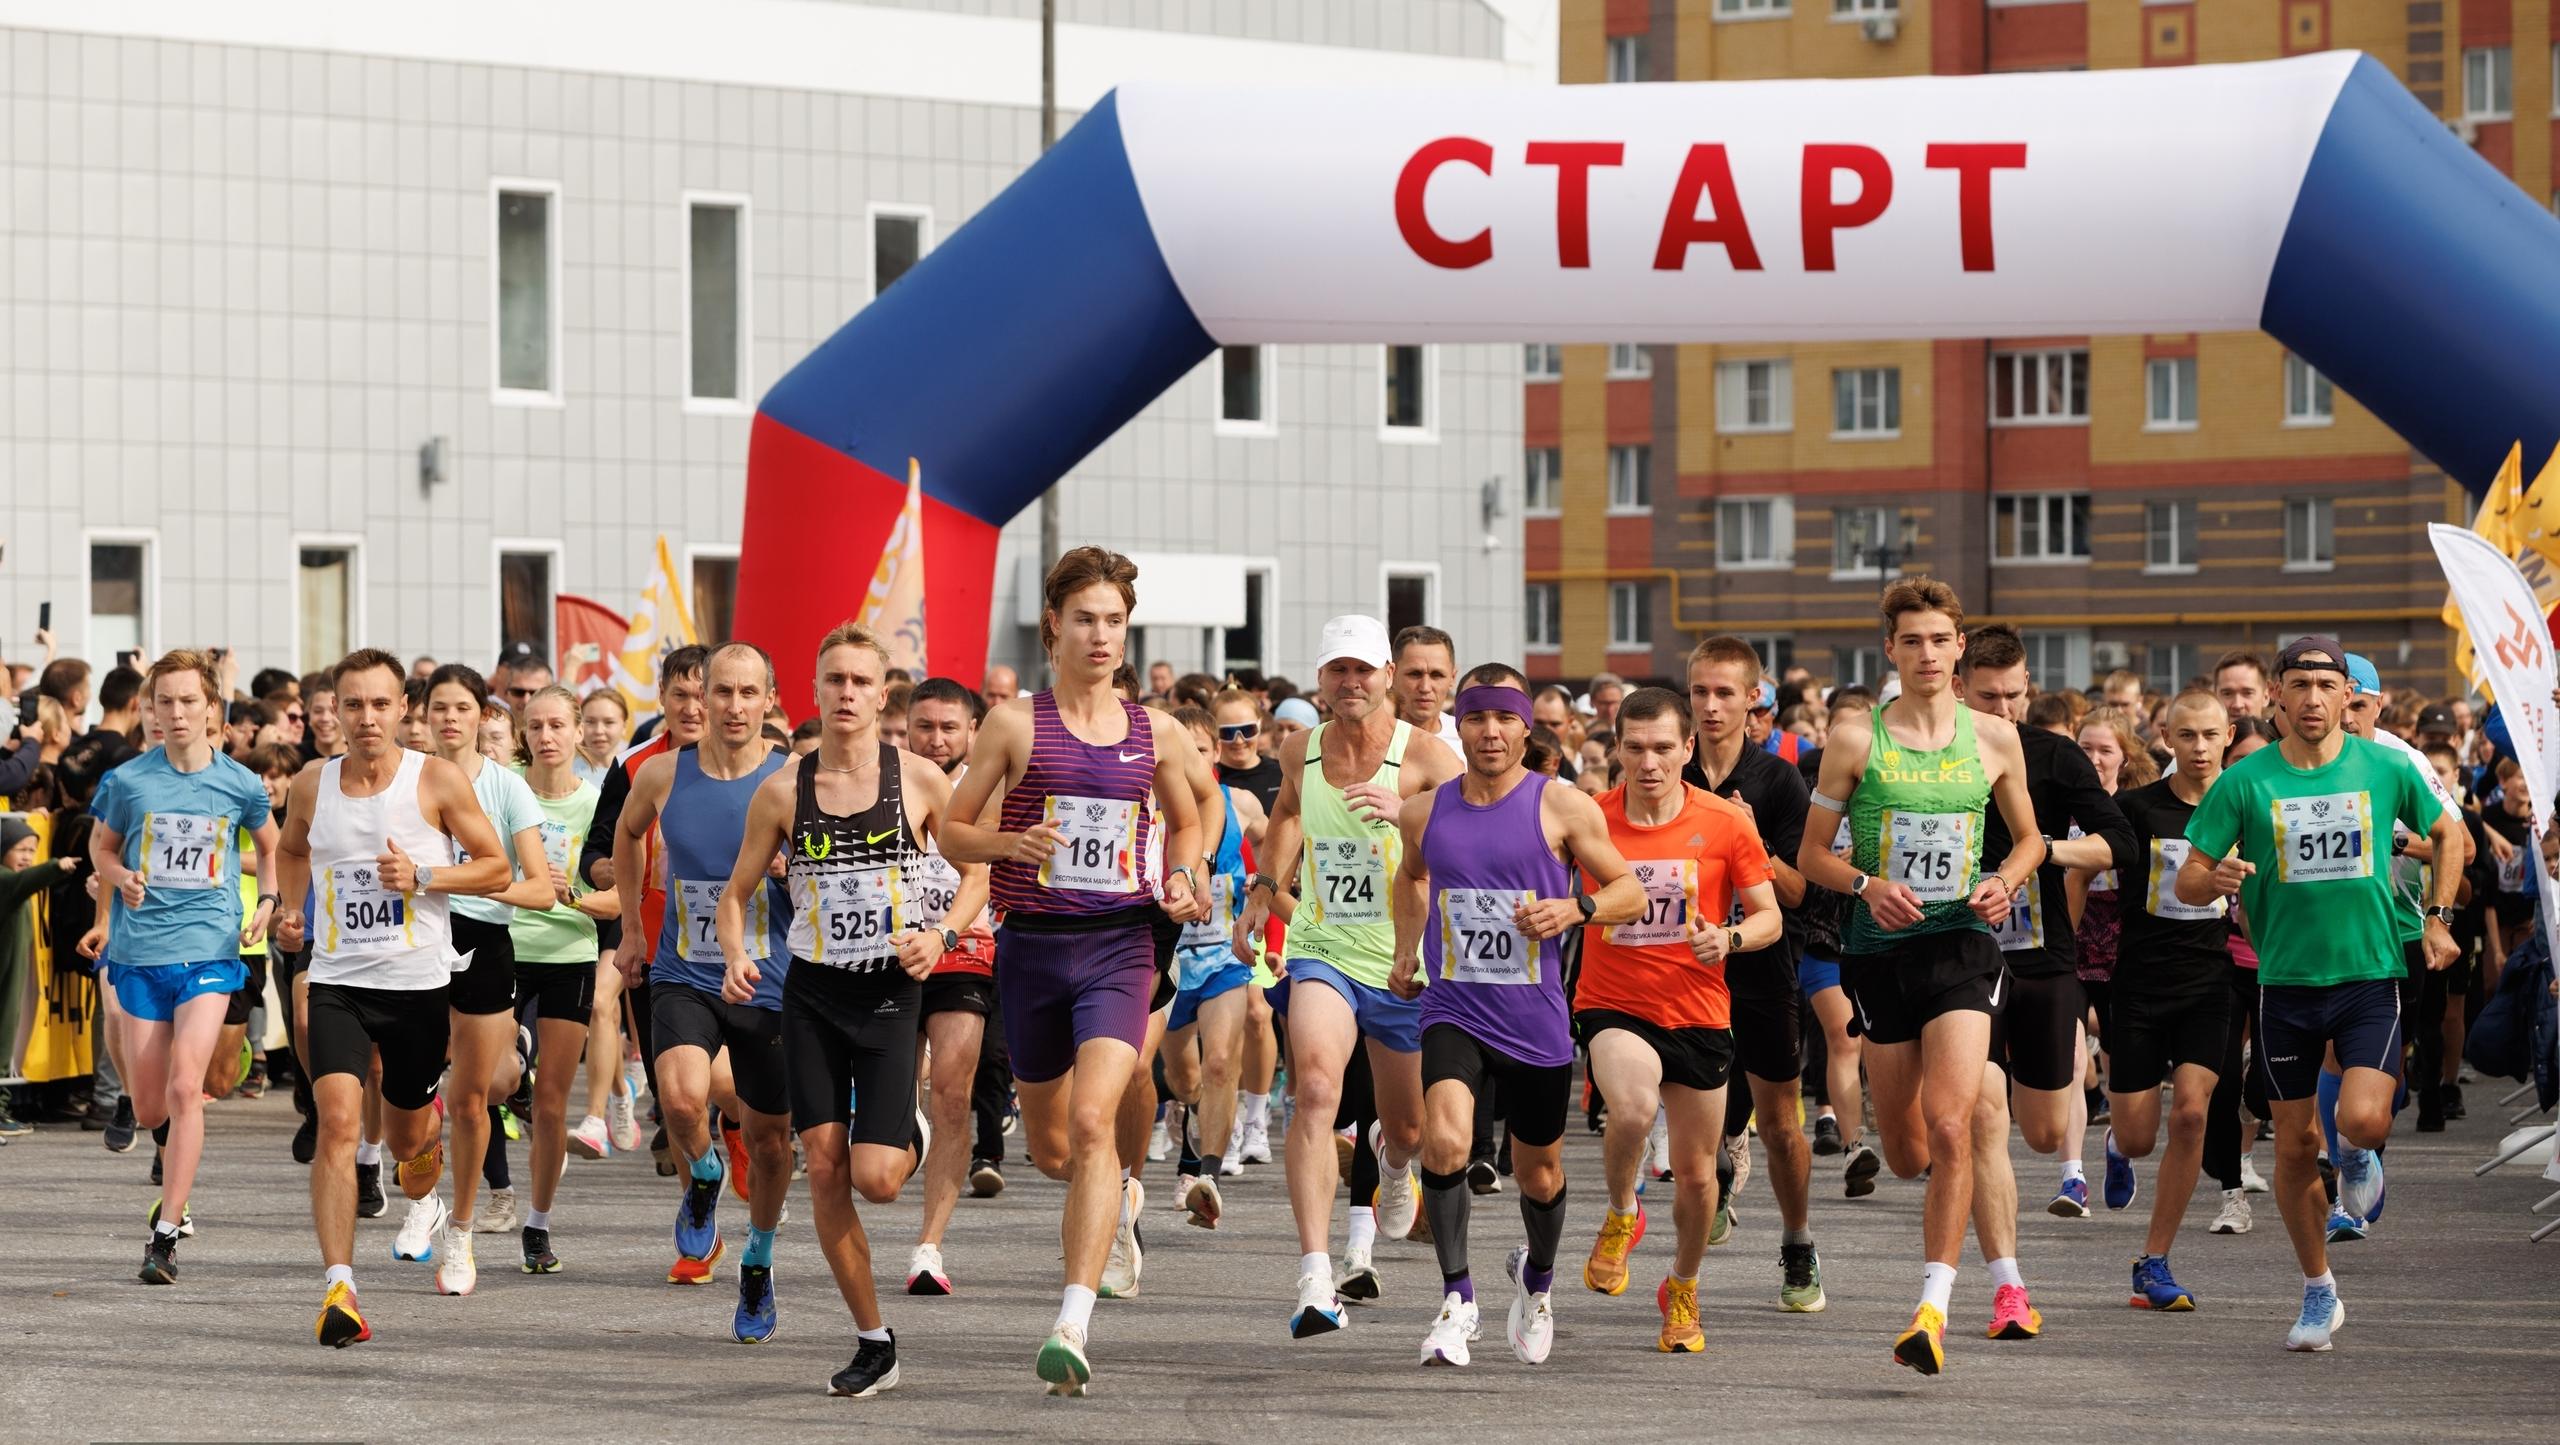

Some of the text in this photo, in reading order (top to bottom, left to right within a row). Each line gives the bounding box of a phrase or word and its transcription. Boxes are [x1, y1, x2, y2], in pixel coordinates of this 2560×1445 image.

[1394, 135, 2028, 271] СТАРТ
[1880, 769, 1973, 784] DUCKS
[546, 822, 567, 833] THE
[163, 845, 203, 871] 147
[1068, 836, 1115, 869] 181
[2299, 830, 2348, 861] 512
[1055, 874, 1093, 884] РЕСПУБЛИКА
[1902, 851, 1951, 880] 715
[2293, 867, 2328, 876] РЕСПУБЛИКА
[1325, 875, 1374, 903] 724
[345, 900, 392, 930] 504
[831, 909, 878, 941] 525
[1627, 897, 1671, 927] 07
[342, 936, 372, 945] РЕСПУБЛИКА
[1460, 929, 1512, 960] 720
[1618, 931, 1651, 940] РЕСПУБЛИКА
[827, 946, 860, 955] РЕСПУБЛИКА
[2270, 1055, 2294, 1063] CRAFT
